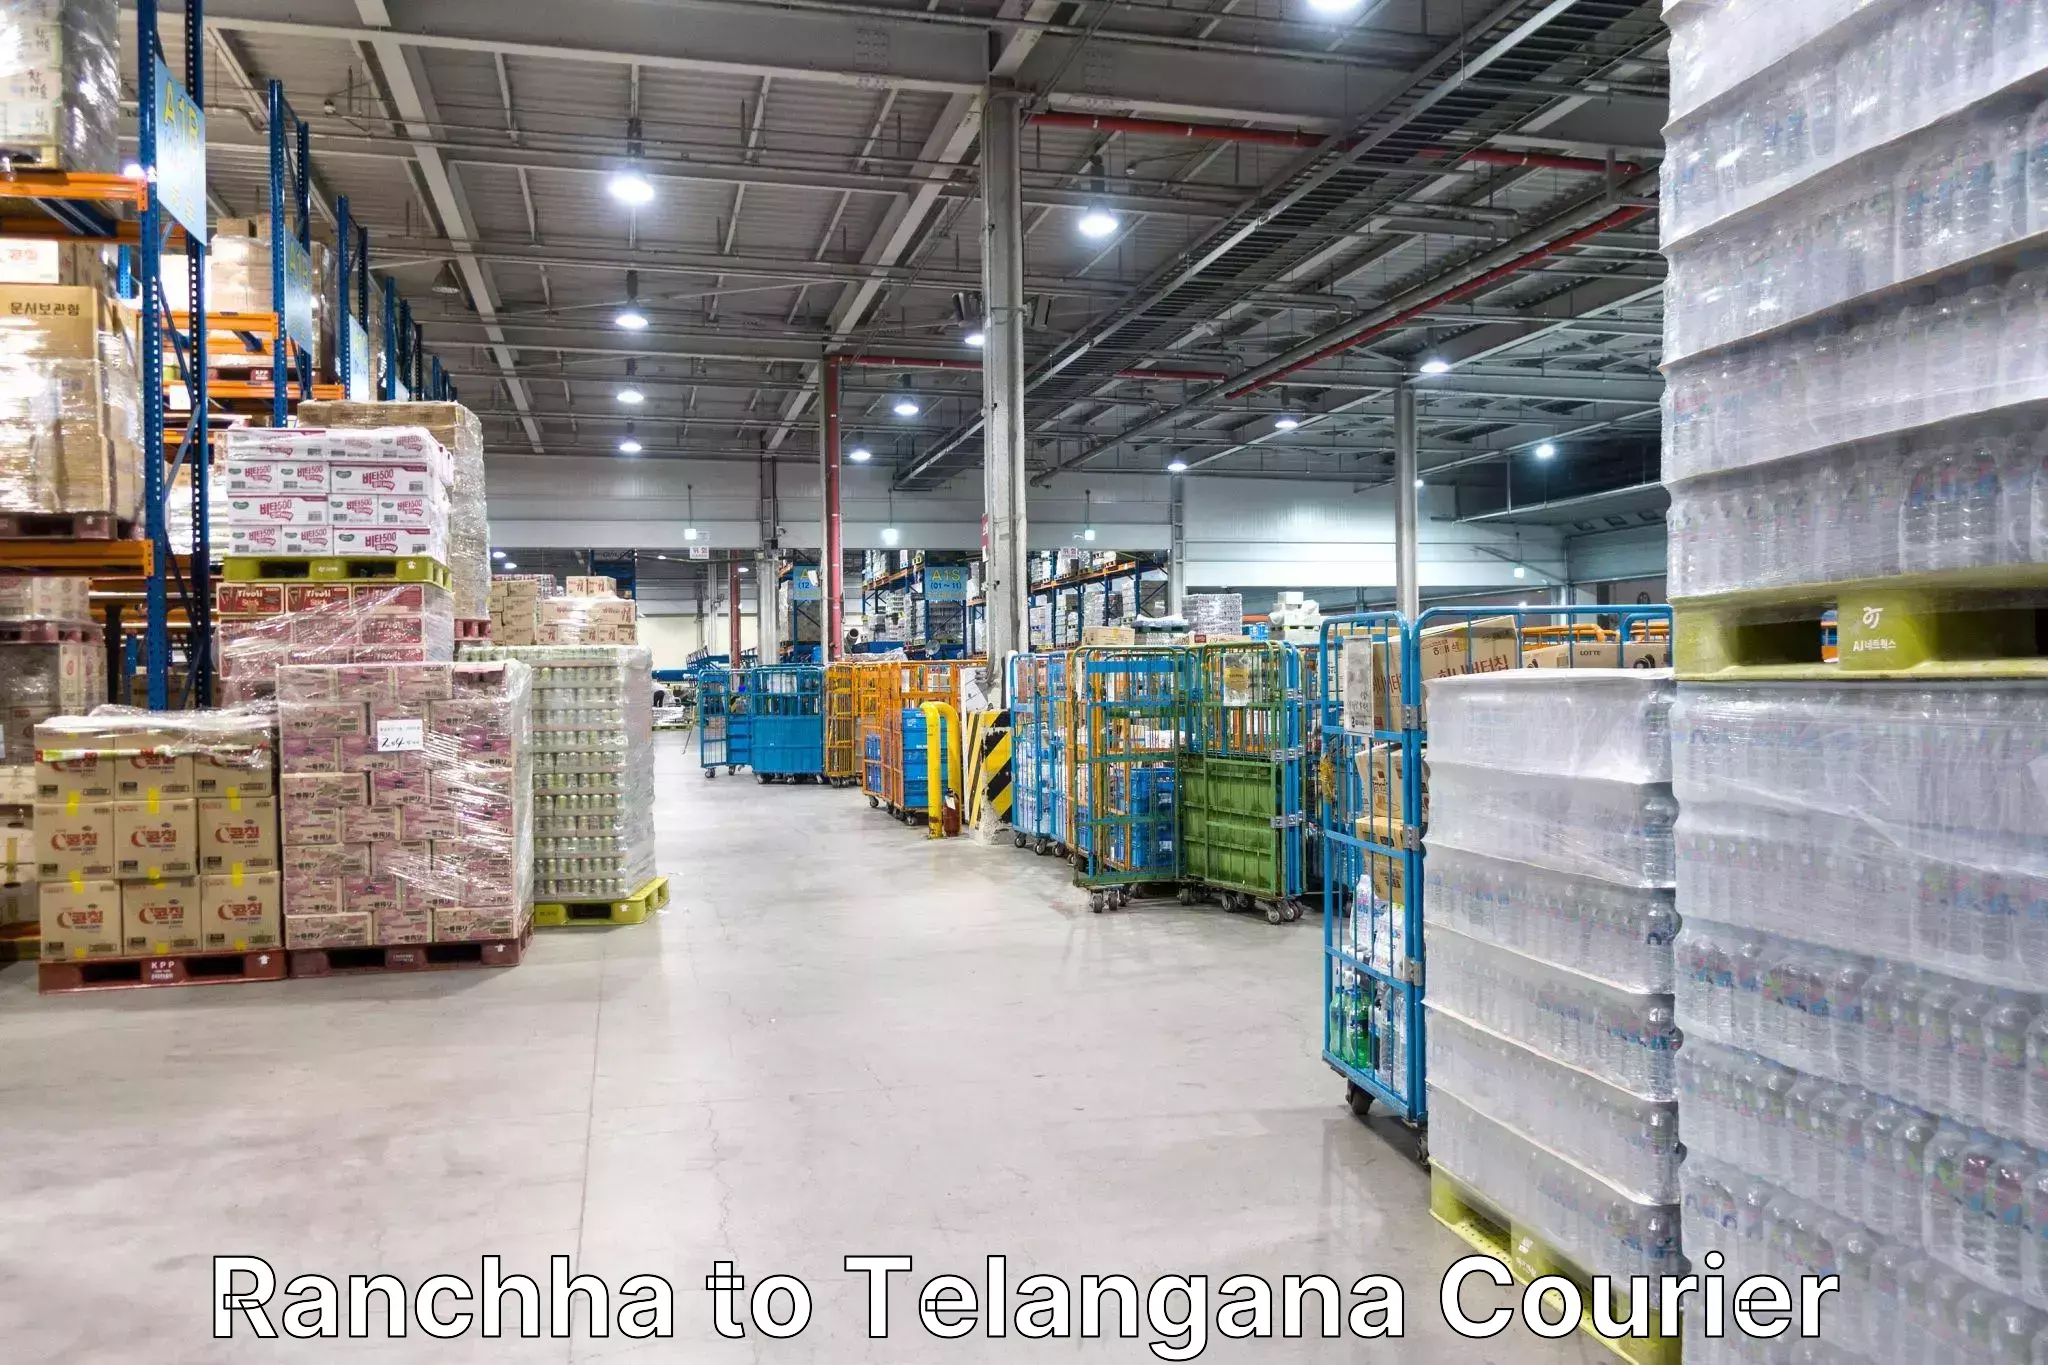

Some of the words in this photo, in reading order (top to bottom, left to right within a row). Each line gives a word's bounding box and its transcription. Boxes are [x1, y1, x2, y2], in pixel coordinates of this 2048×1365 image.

[362, 469, 394, 485] 비타500
[260, 500, 292, 516] 비타500
[365, 532, 397, 548] 비타500
[931, 569, 960, 581] A1S
